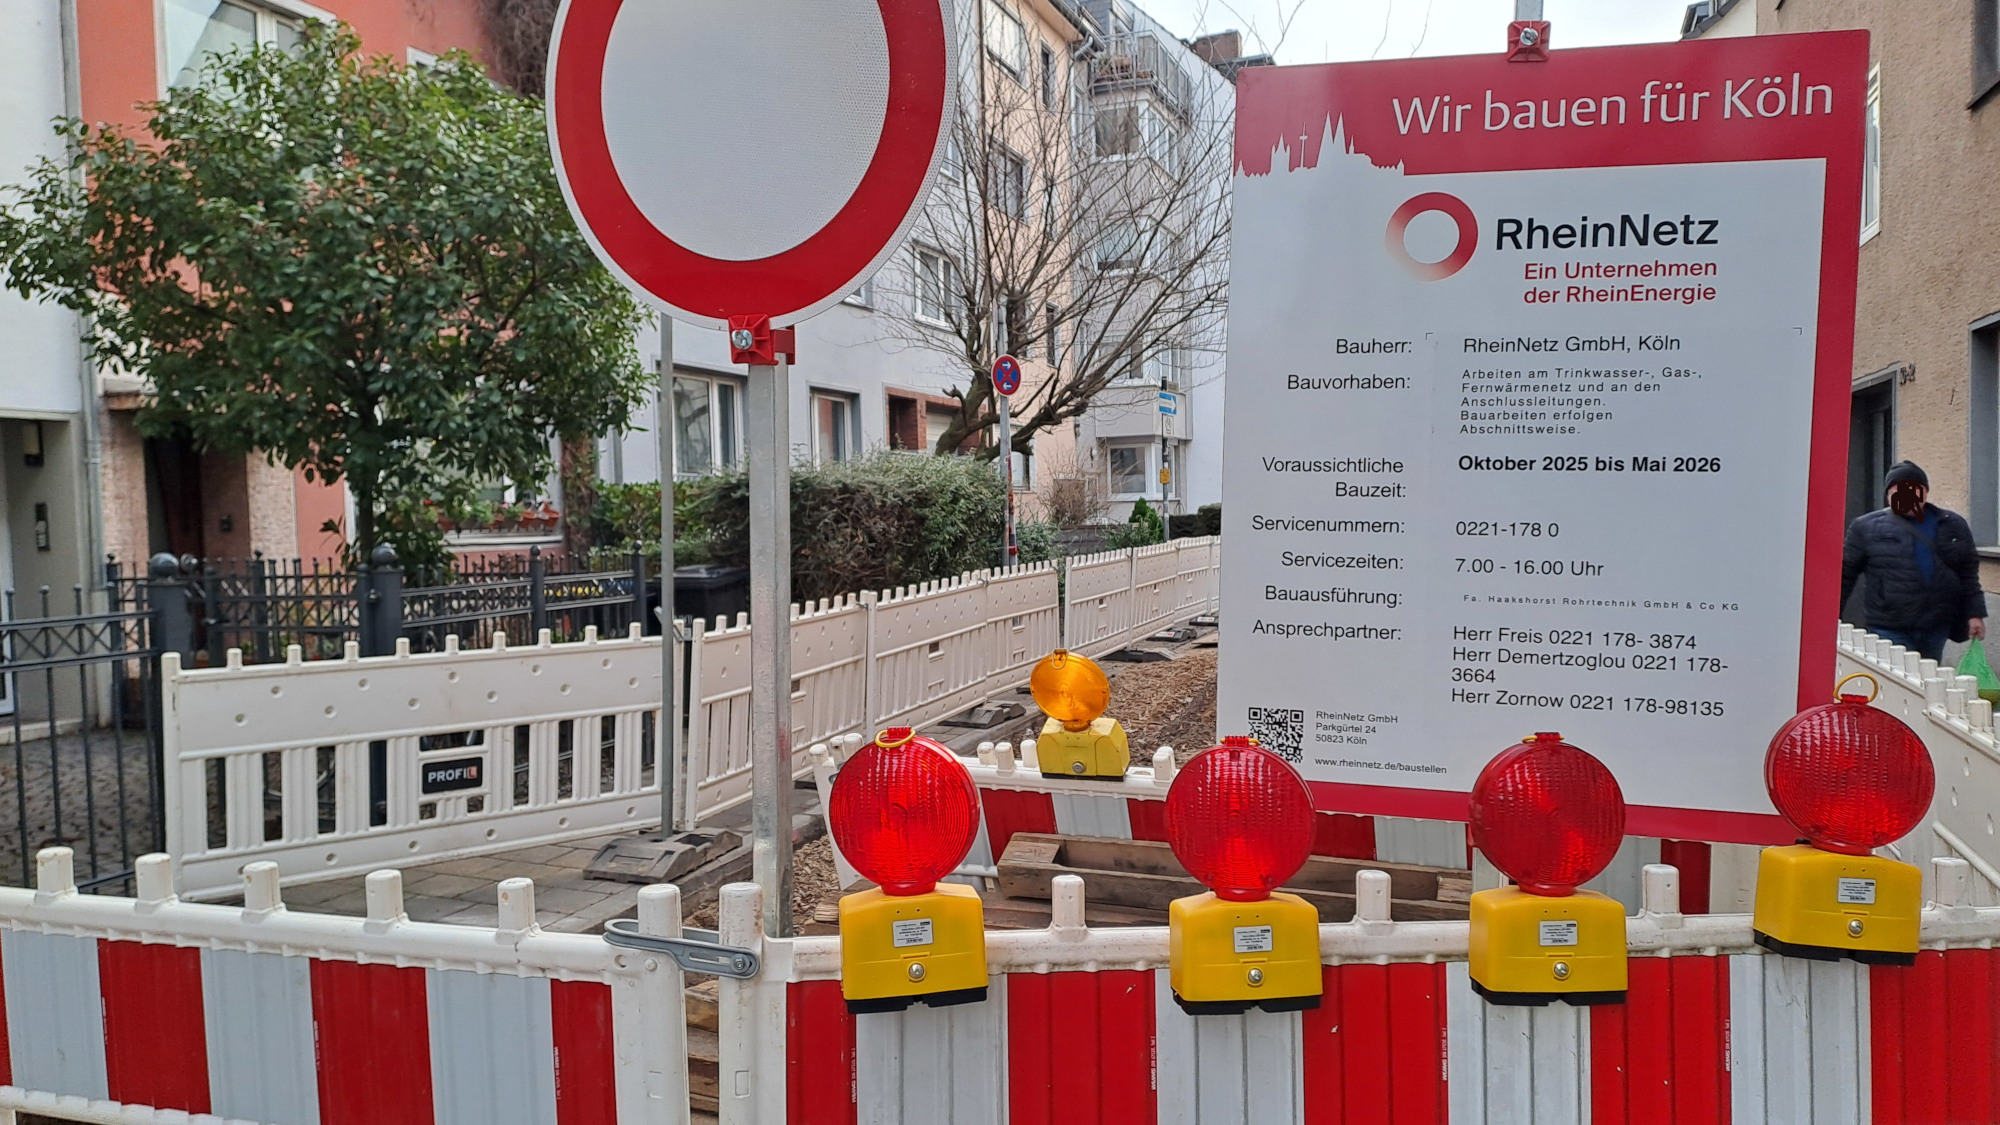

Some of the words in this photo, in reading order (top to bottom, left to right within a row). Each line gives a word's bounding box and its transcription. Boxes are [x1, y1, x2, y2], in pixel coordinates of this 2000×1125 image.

[1393, 96, 1471, 134] Wir
[1485, 90, 1625, 130] bauen
[1640, 81, 1709, 122] für
[1724, 73, 1832, 118] Köln
[1497, 214, 1718, 250] RheinNetz
[1525, 263, 1556, 279] Ein
[1565, 260, 1716, 278] Unternehmen
[1524, 287, 1560, 303] der
[1567, 284, 1716, 304] RheinEnergie
[1337, 338, 1411, 353] Bauherr:
[1464, 337, 1558, 352] RheinNetz
[1566, 336, 1630, 353] GmbH,
[1639, 336, 1680, 350] Köln
[1462, 369, 1521, 379] Arbeiten
[1555, 368, 1654, 379] Trinkwasser-,
[1662, 367, 1701, 378] Gas-,
[1288, 374, 1410, 389] Bauvorhaben:
[1462, 383, 1571, 392] Fernwärmenetz
[1579, 382, 1603, 392] und
[1635, 382, 1660, 391] den
[1461, 396, 1605, 408] Anschlussleitungen.
[1461, 410, 1545, 420] Bauarbeiten
[1553, 410, 1612, 422] erfolgen
[1460, 424, 1580, 434] Abschnittsweise.
[1263, 457, 1403, 473] Voraussichtliche
[1459, 456, 1536, 470] Oktober
[1543, 457, 1588, 471] 2025
[1596, 457, 1624, 471] bis
[1633, 457, 1666, 471] Mai
[1673, 457, 1720, 472] 2026
[1336, 482, 1405, 497] Bauzeit:
[1252, 515, 1404, 533] Servicenummern:
[1456, 522, 1541, 537] 0221-178
[1548, 523, 1559, 537] 0
[1282, 552, 1403, 569] Servicezeiten:
[1456, 559, 1493, 573] 7.00
[1515, 560, 1563, 575] 16.00
[1572, 561, 1604, 576] Uhr
[1266, 585, 1402, 608] Bauausführung:
[1489, 596, 1555, 604] Haakshorst
[1563, 598, 1636, 607] Rohrtechnik
[1700, 602, 1714, 610] Co
[1253, 620, 1401, 641] Ansprechpartner:
[1454, 626, 1492, 641] Herr
[1499, 628, 1542, 643] Freis
[1549, 630, 1591, 645] 0221
[1603, 632, 1643, 647] 178-
[1650, 634, 1696, 649] 3874
[1454, 647, 1491, 662] Herr
[1498, 648, 1625, 671] Demertzoglou
[1633, 655, 1675, 670] 0221
[1688, 657, 1728, 672] 178-
[1452, 668, 1495, 683] 3664
[1452, 688, 1490, 703] Herr
[1496, 690, 1563, 707] Zornow
[1570, 695, 1612, 710] 0221
[1624, 698, 1723, 716] 178-98135
[1316, 711, 1364, 721] RheinNetz
[1368, 714, 1397, 723] GmbH
[1316, 723, 1362, 733] Parkgürtel
[1316, 734, 1343, 743] 50823
[1347, 736, 1367, 744] Köln
[1315, 759, 1446, 773] www.rheinnetz.de/baustellen
[428, 766, 478, 783] PROFIL
